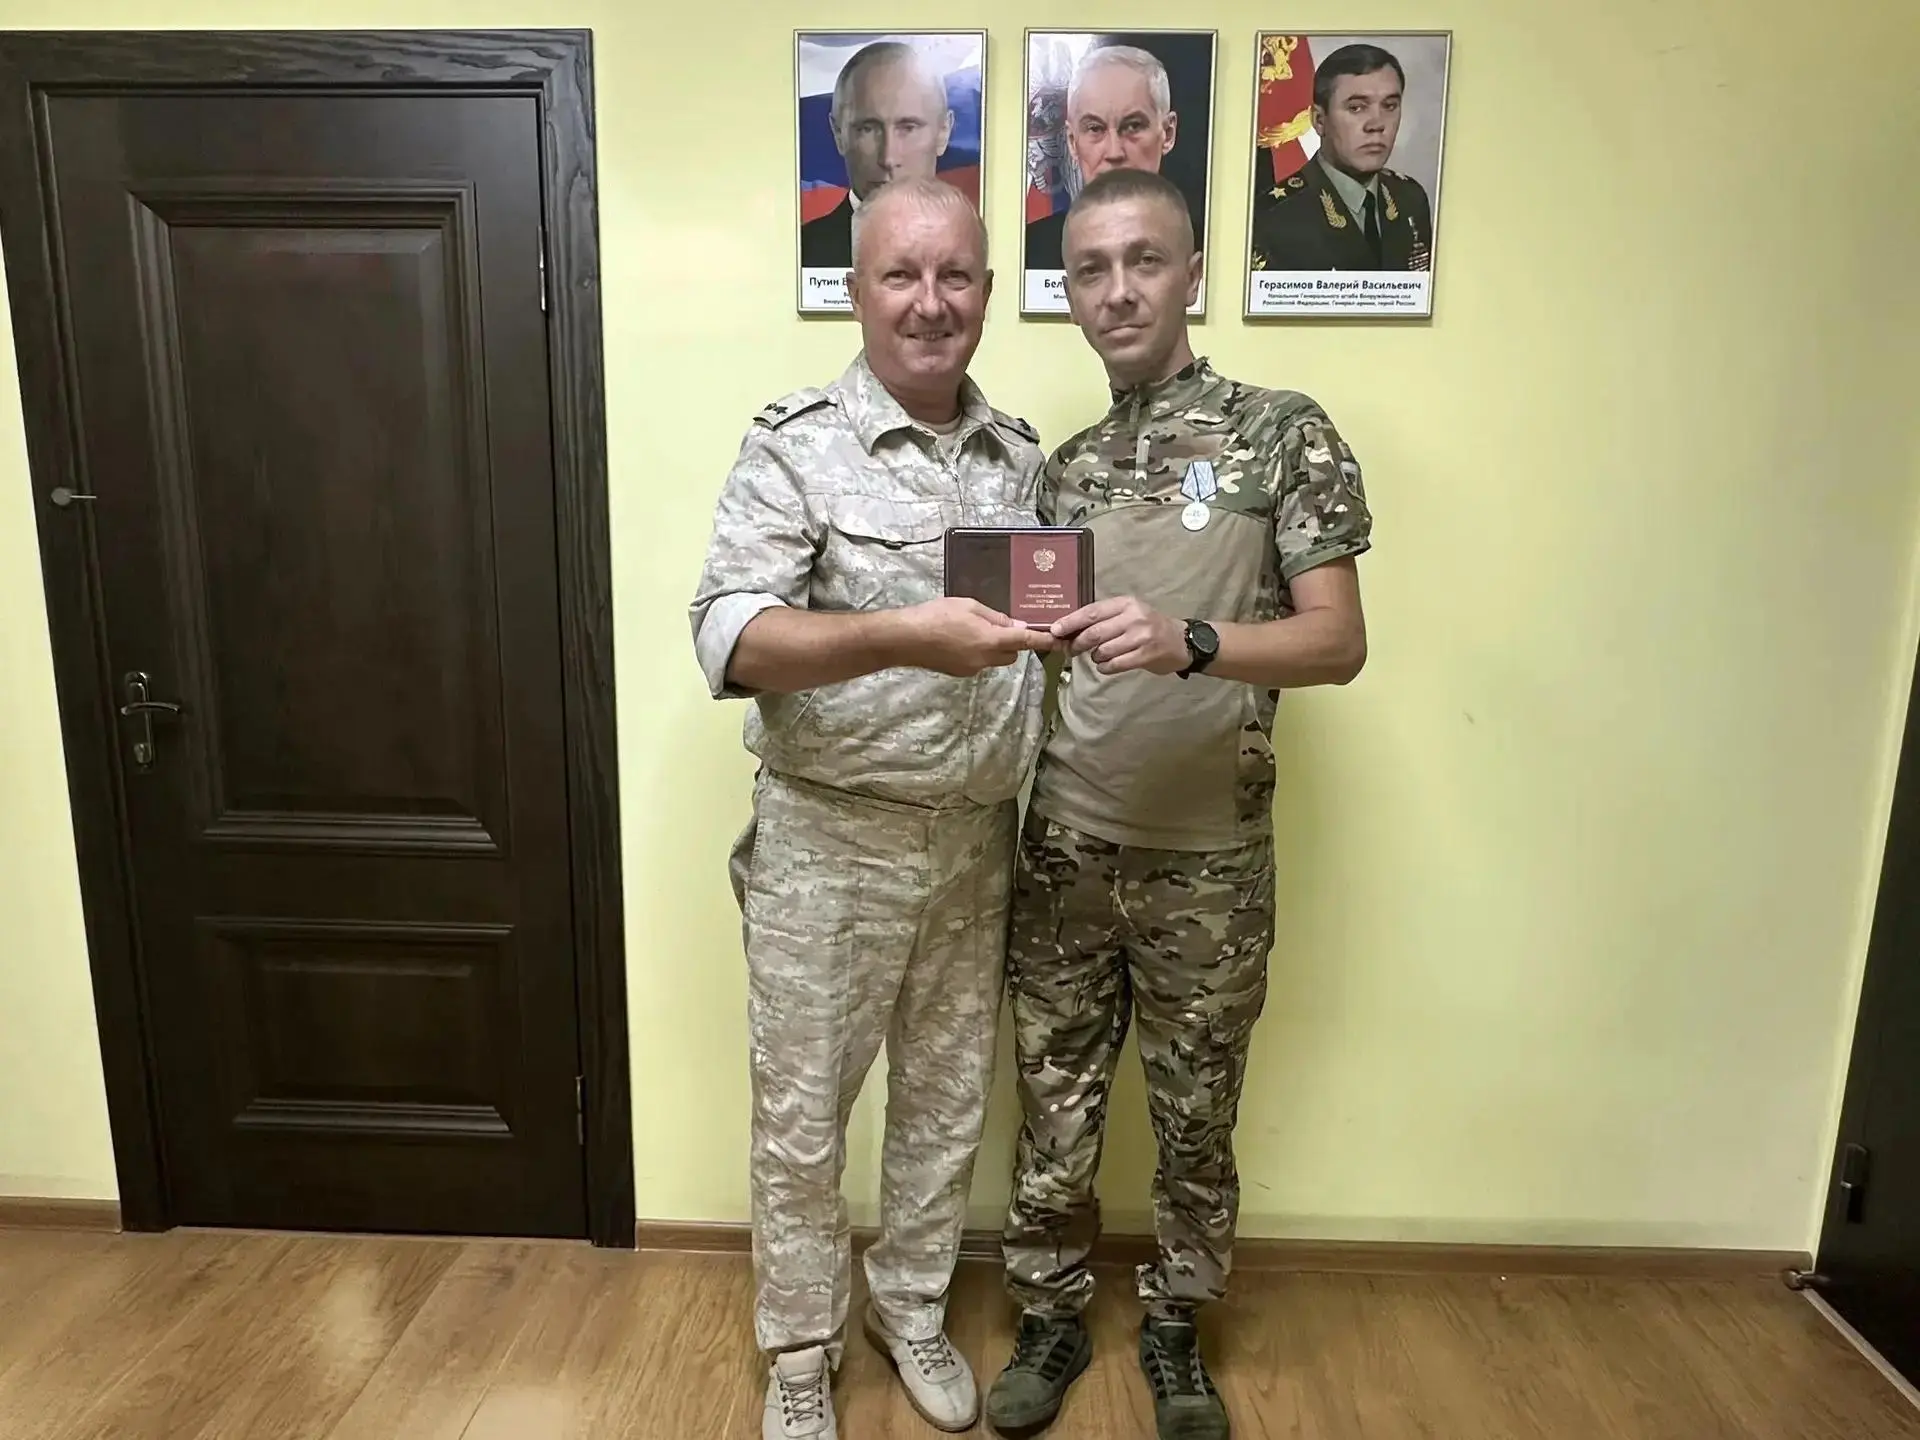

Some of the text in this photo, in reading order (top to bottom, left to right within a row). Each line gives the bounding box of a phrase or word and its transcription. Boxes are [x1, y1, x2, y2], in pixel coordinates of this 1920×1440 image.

[809, 276, 839, 288] Путин
[1259, 279, 1422, 292] Герасимов Валерий Васильевич
